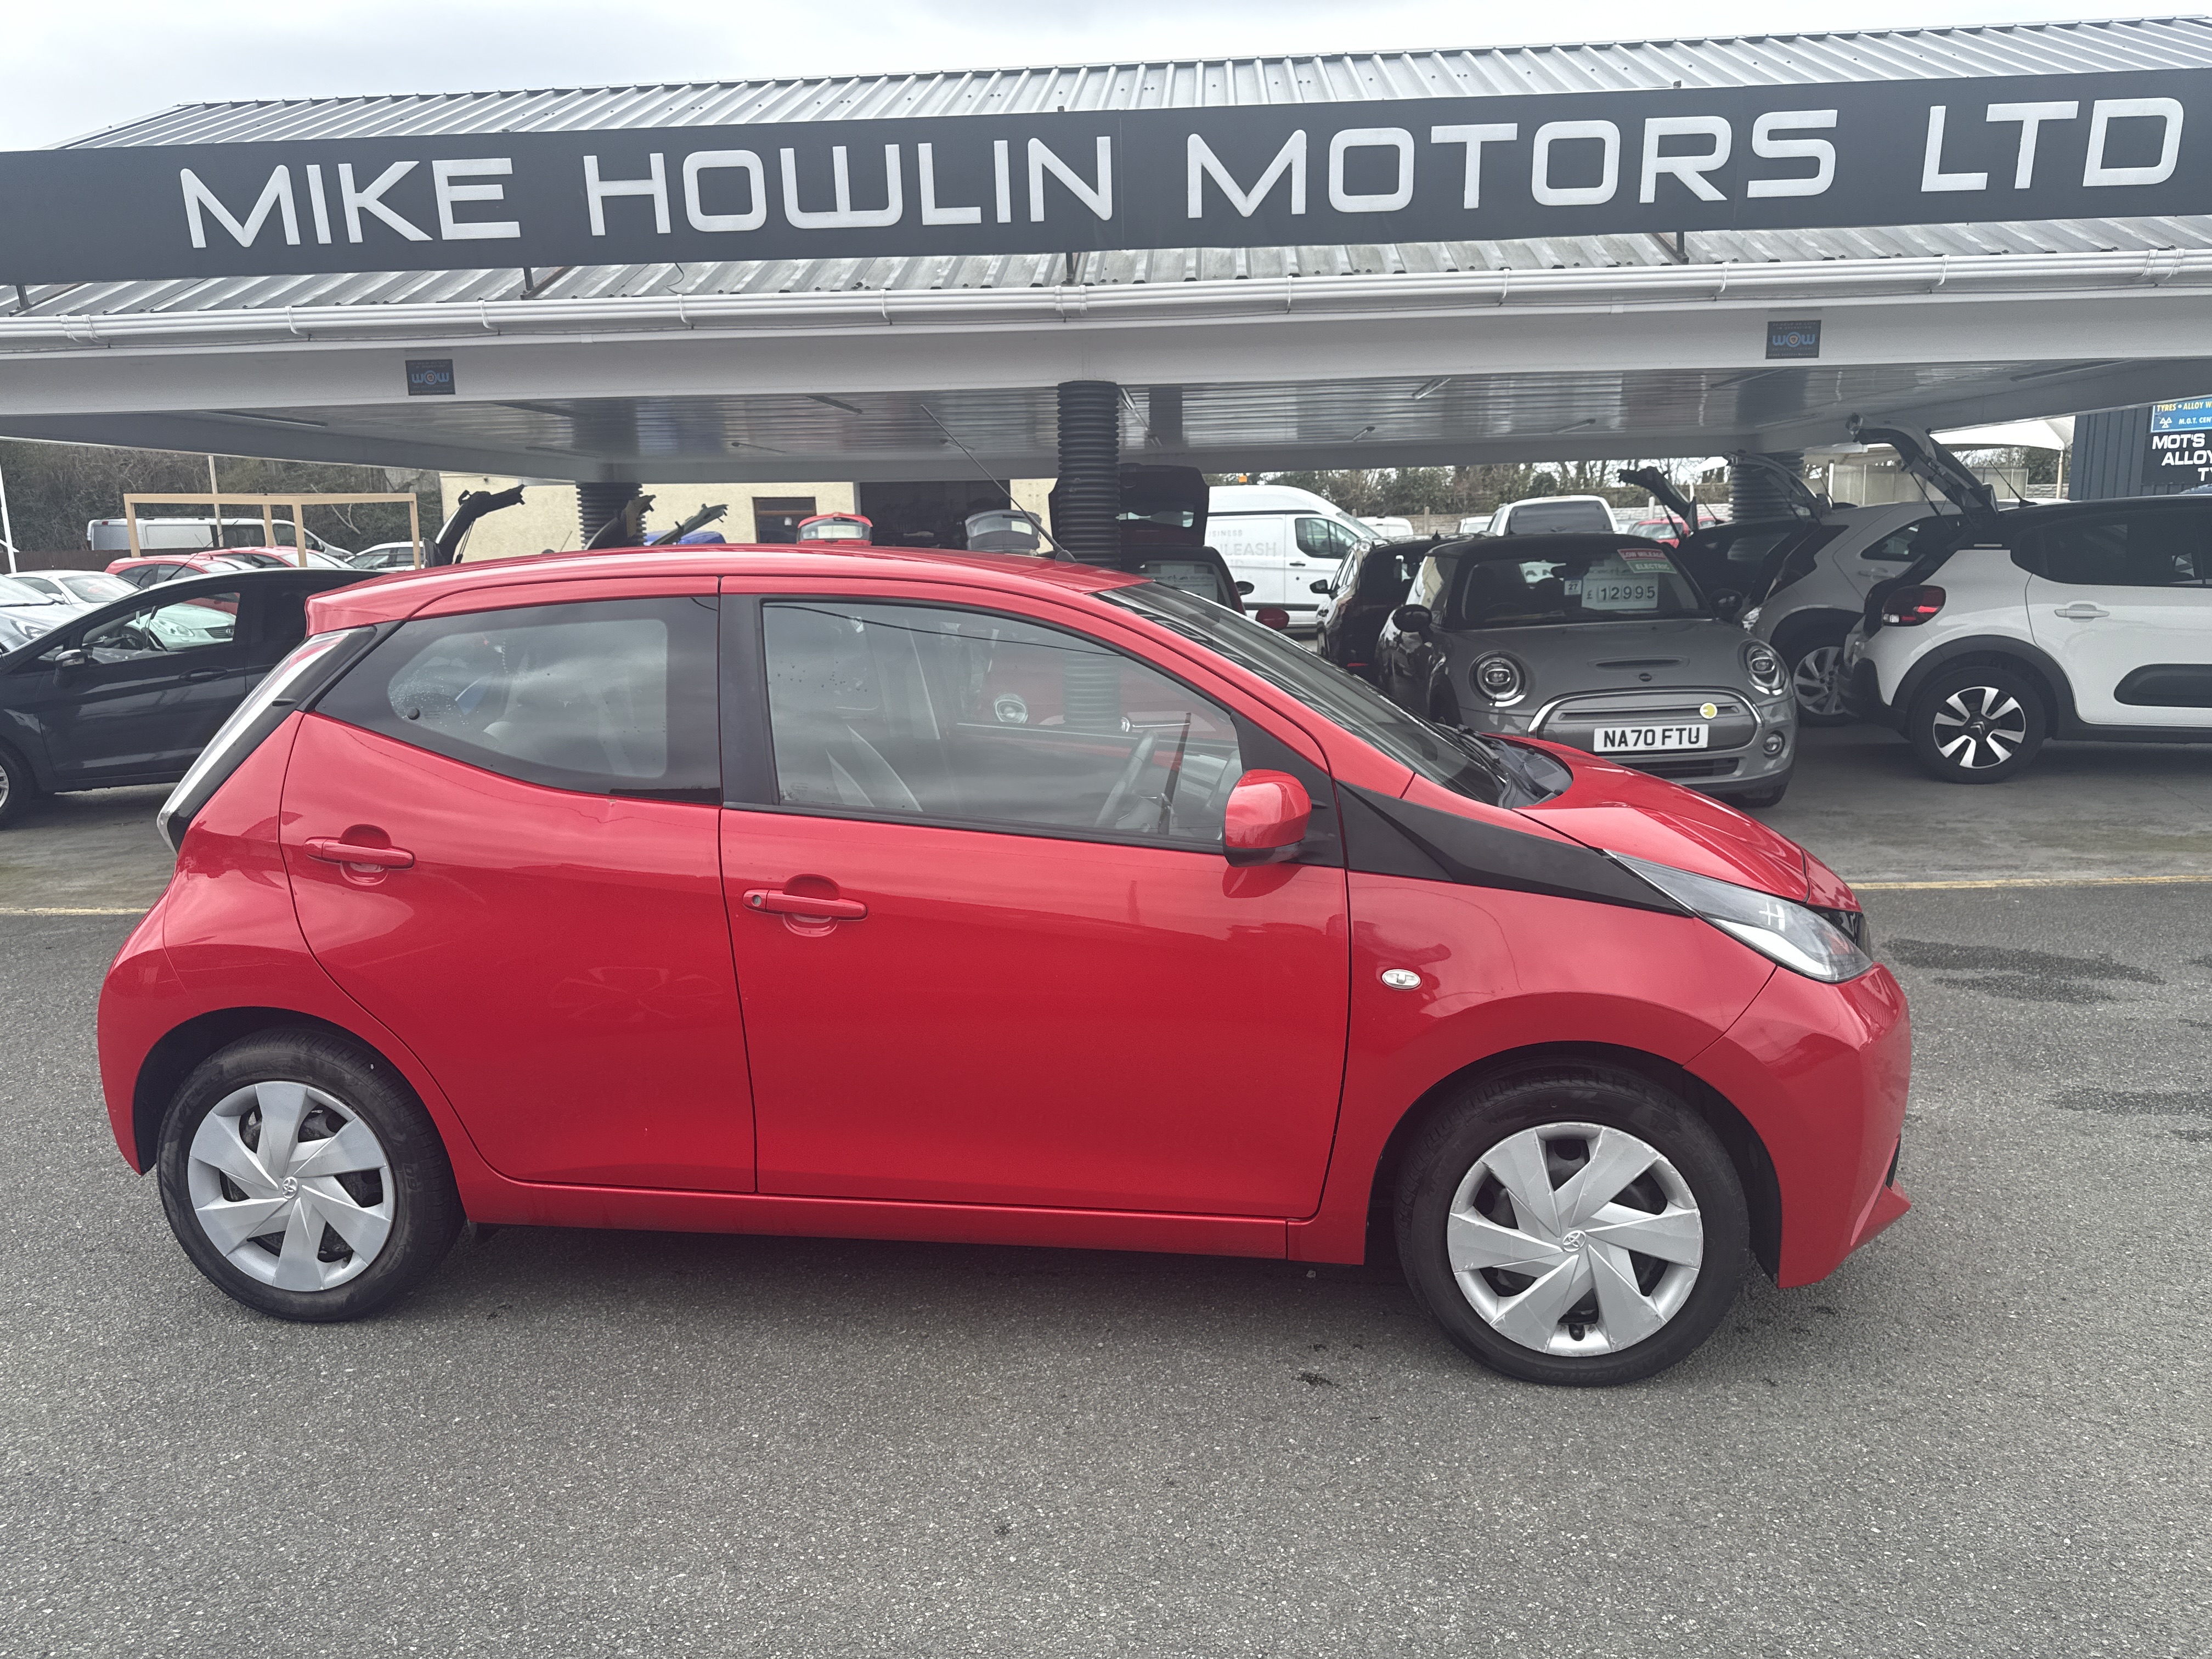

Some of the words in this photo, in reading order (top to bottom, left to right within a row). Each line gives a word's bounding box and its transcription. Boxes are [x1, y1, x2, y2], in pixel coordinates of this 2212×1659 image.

[180, 157, 521, 249] MIKE
[583, 136, 1113, 236] HOWLIN
[1187, 109, 1838, 218] MOTORS
[1921, 97, 2184, 192] LTD
[2183, 402, 2204, 410] ALLOY
[2152, 433, 2205, 449] MOT'S
[1604, 729, 1656, 748] NA70
[1661, 727, 1700, 745] FTU
